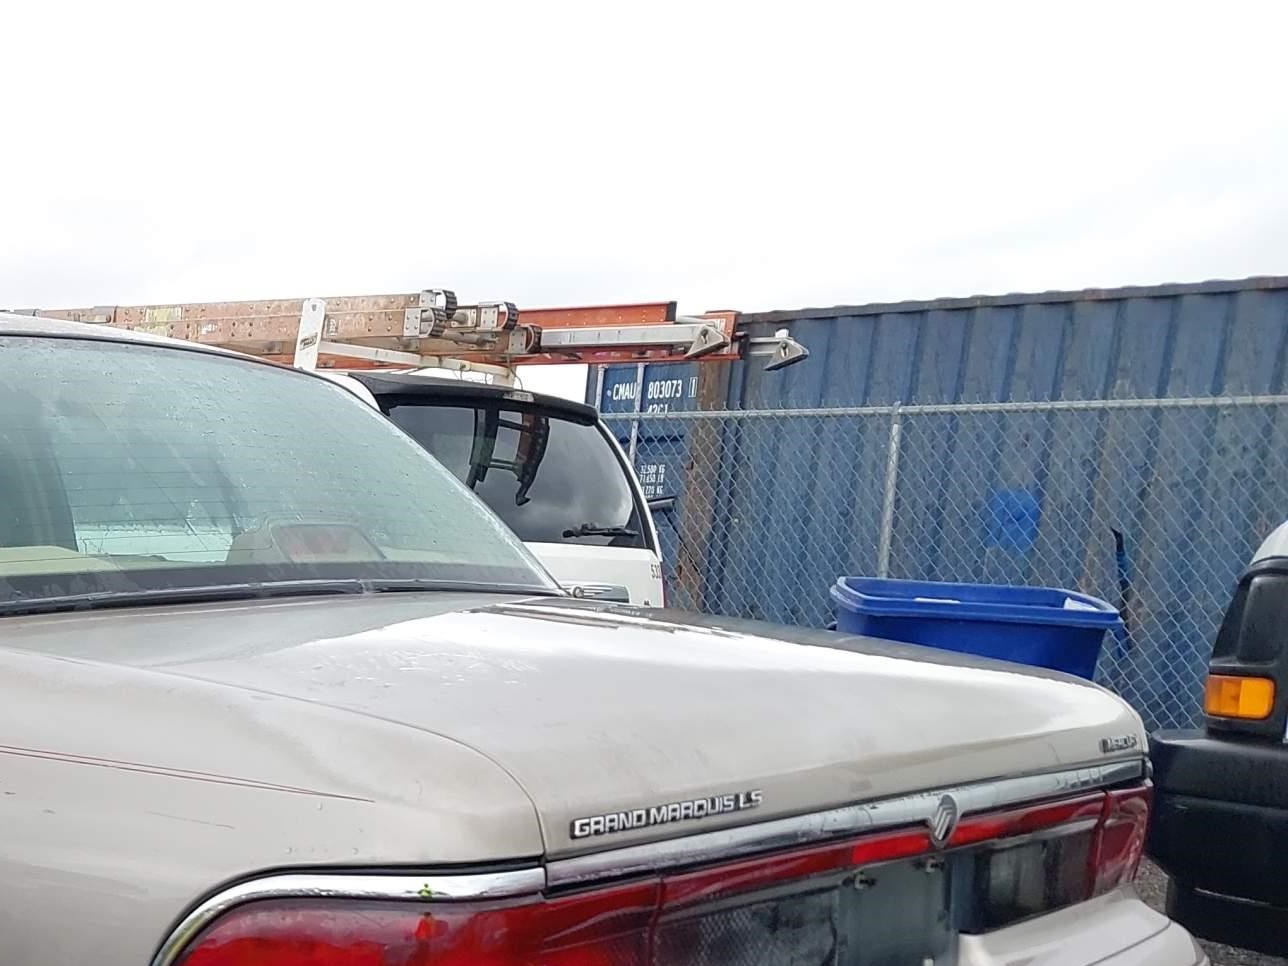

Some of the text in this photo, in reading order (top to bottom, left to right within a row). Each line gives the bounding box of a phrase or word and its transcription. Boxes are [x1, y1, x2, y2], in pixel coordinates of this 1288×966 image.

[613, 382, 637, 400] CMAU
[647, 379, 682, 399] 803073
[572, 789, 763, 838] GRAND MARQUIS LS
